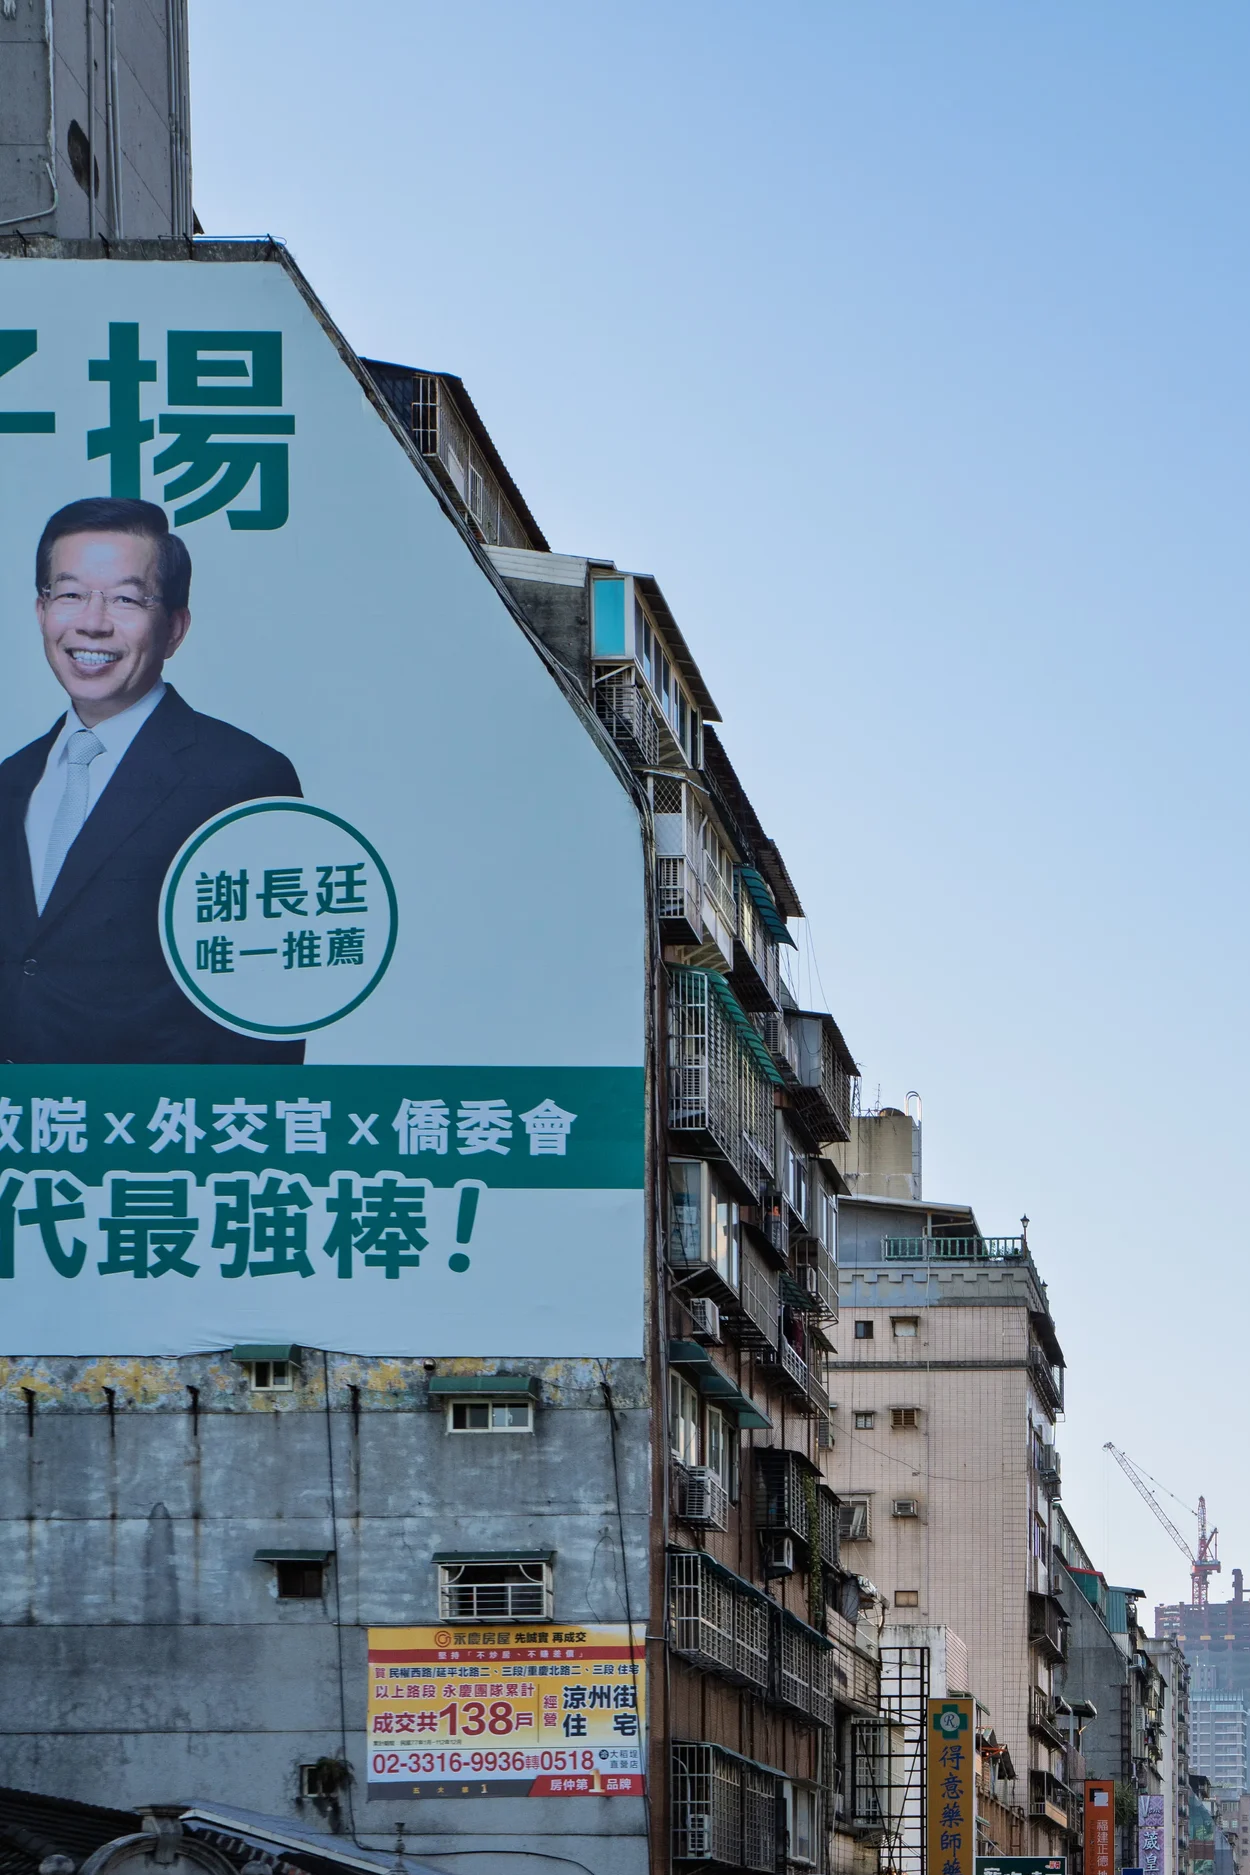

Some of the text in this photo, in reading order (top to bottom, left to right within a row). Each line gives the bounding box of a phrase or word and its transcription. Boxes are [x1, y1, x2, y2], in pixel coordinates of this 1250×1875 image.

[195, 862, 367, 923] 謝長廷
[196, 927, 365, 974] 唯一推薦
[147, 1098, 331, 1155] 外交官
[391, 1099, 577, 1157] 僑委會
[453, 1631, 587, 1646] 永慶房屋 先誠實 再成交
[374, 1667, 385, 1679] 賀
[618, 1664, 639, 1676] 住宅
[375, 1683, 535, 1698] 以上路段 永慶團隊累計
[562, 1685, 638, 1711] 涼州街
[562, 1713, 638, 1738] 住宅
[373, 1751, 594, 1774] 02-3316-9936轉0518
